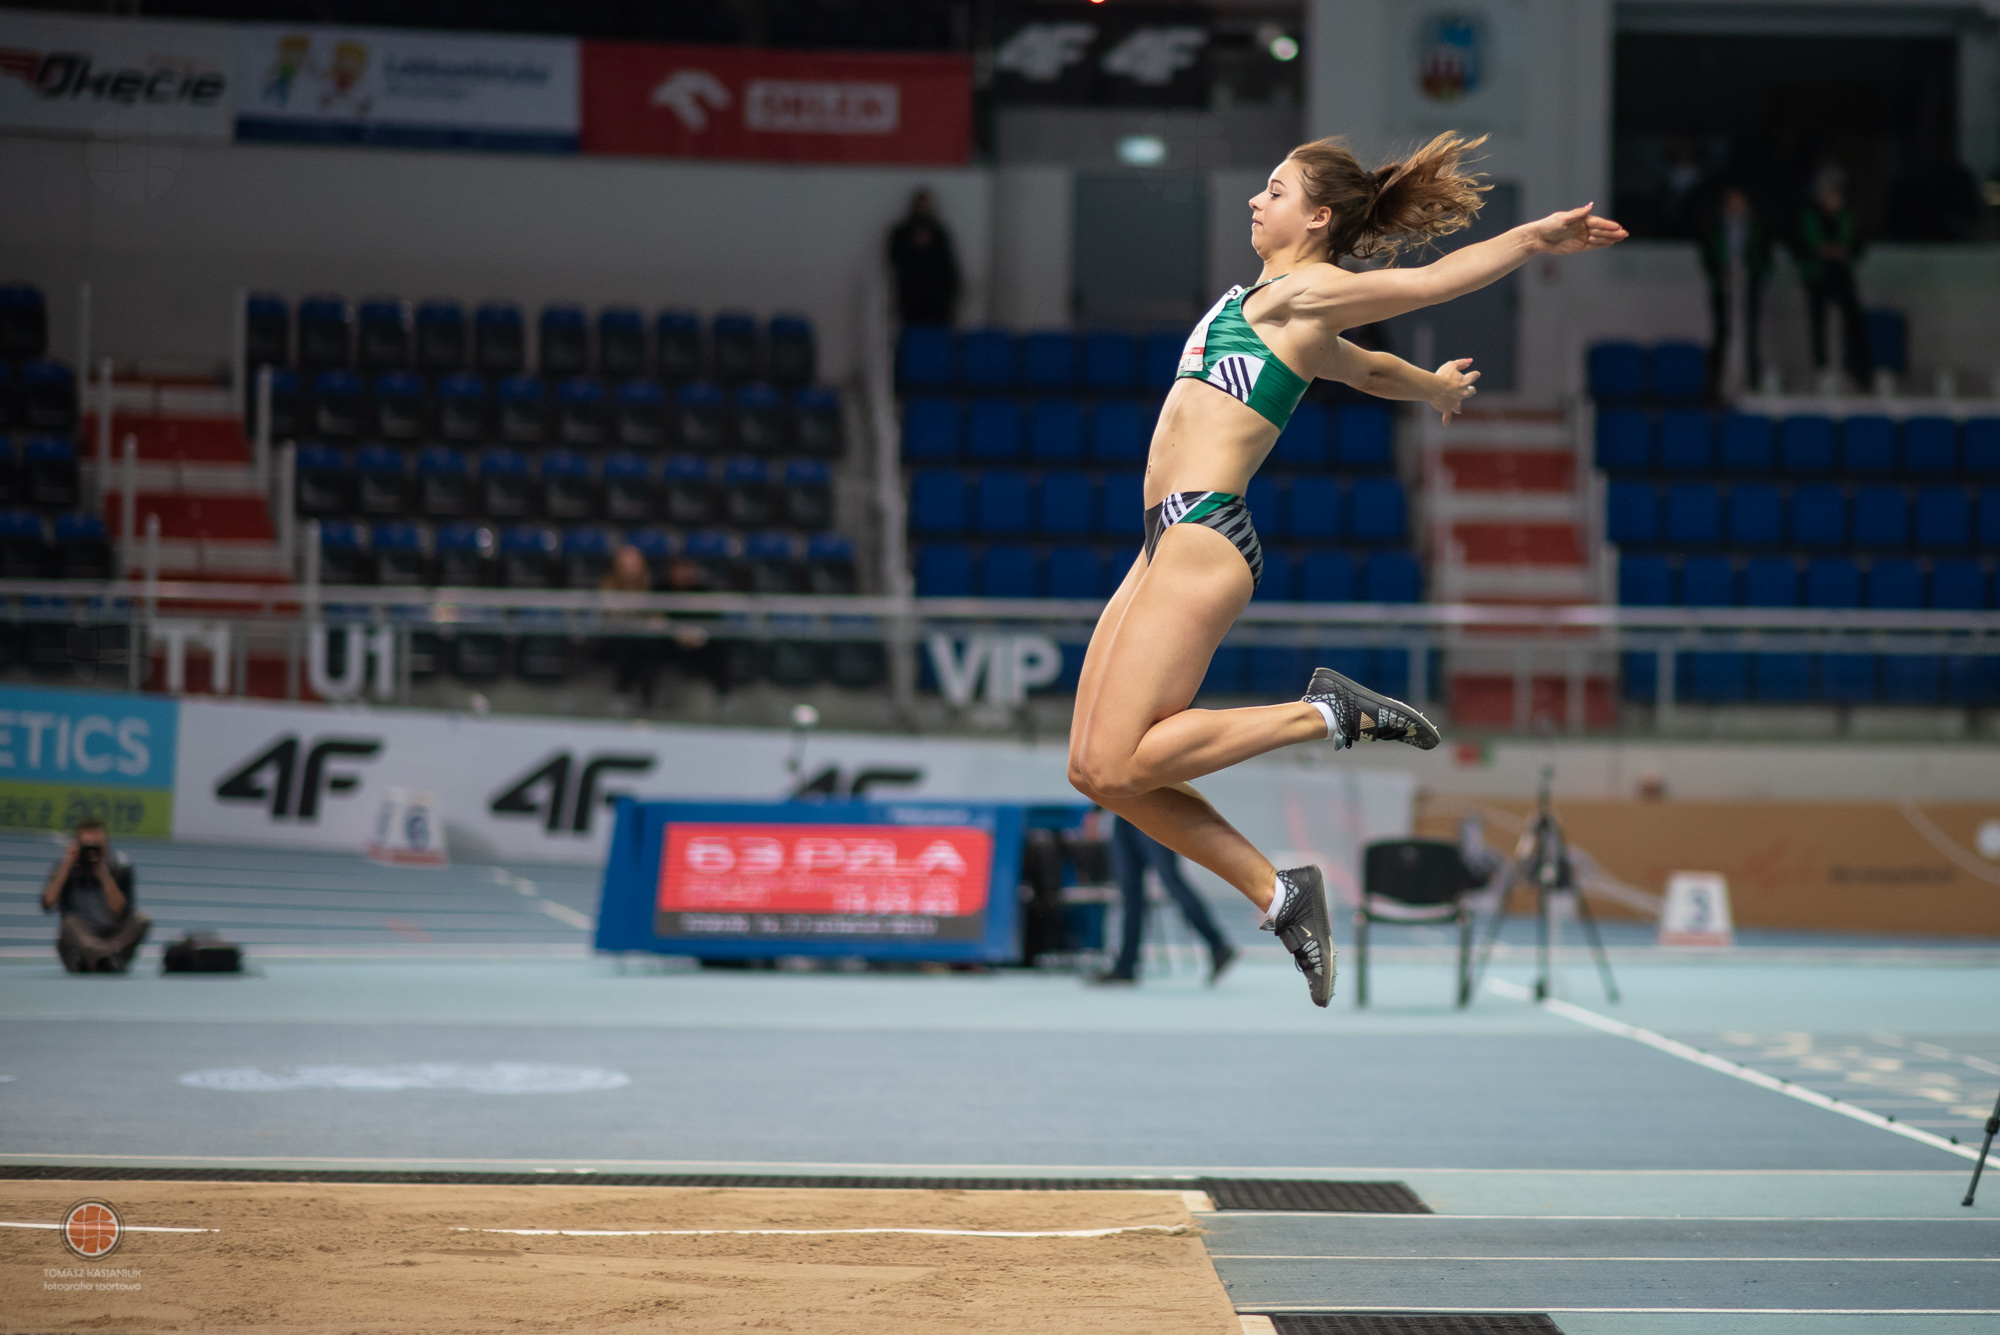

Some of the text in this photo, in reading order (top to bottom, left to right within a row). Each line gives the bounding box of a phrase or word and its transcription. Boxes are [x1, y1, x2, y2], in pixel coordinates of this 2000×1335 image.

[929, 633, 1063, 707] VIP
[214, 733, 385, 820] 4F
[488, 749, 658, 833] 4F
